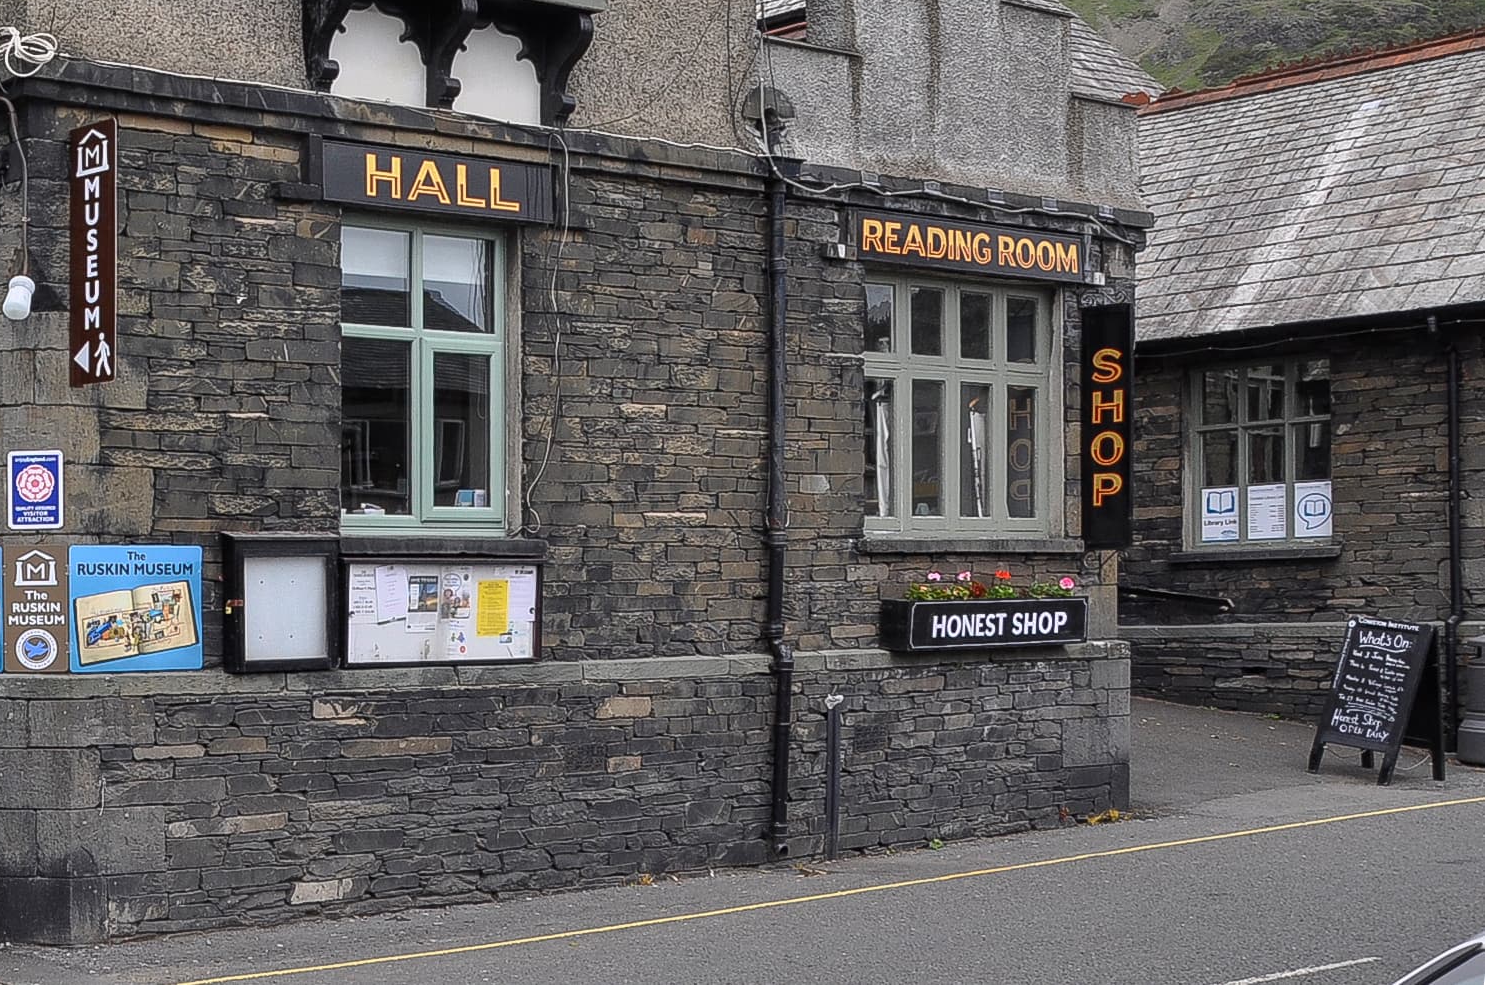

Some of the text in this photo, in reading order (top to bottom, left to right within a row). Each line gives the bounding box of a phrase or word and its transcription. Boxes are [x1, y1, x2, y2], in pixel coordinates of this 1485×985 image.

[365, 152, 521, 212] HALL
[83, 175, 101, 331] MUSEUM
[862, 218, 1079, 274] READING ROOM
[1091, 348, 1124, 507] SHOP
[127, 551, 146, 561] The
[77, 563, 193, 575] RUSKIN MUSEUM
[24, 590, 48, 600] The
[12, 602, 61, 613] RUSKIN
[8, 614, 65, 626] MUSEUM
[931, 611, 1068, 639] HONEST SHOP
[1359, 630, 1392, 646] What's
